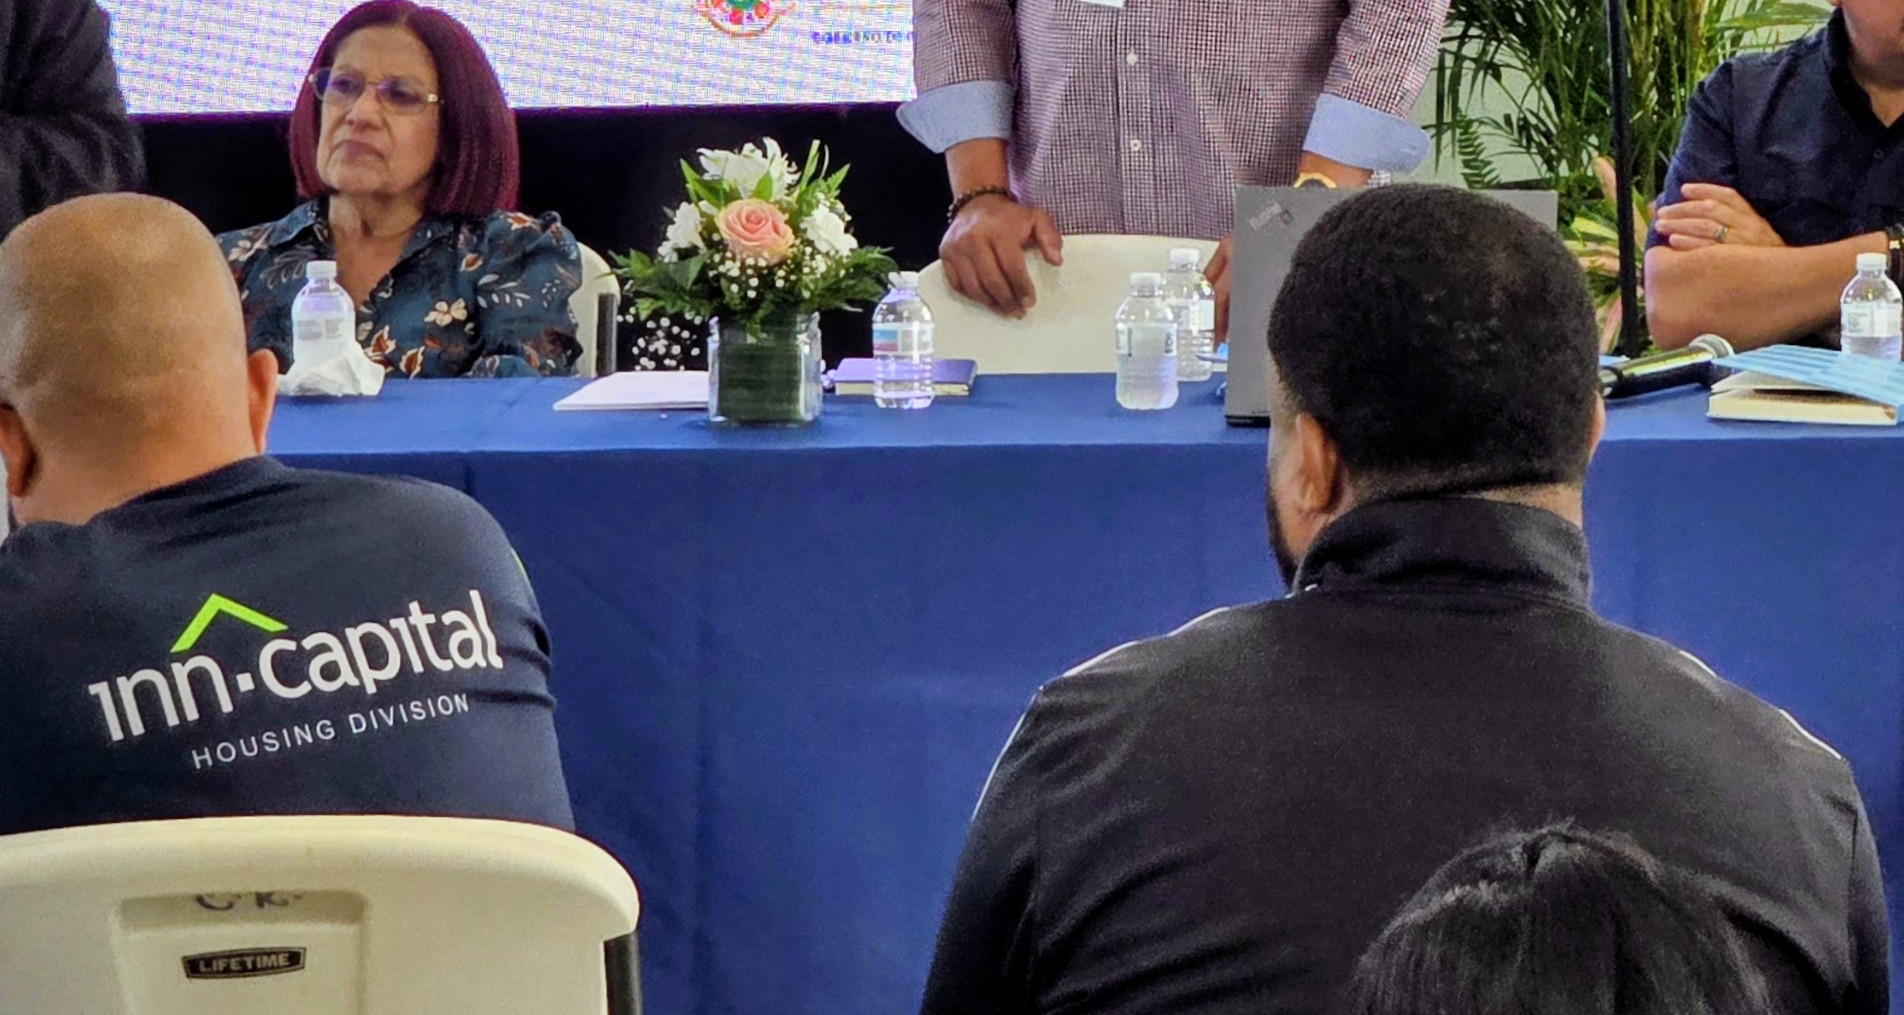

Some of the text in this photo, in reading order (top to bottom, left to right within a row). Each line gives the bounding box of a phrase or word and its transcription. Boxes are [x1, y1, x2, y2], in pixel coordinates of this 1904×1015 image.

[191, 692, 470, 770] HOUSING DIVISION
[198, 952, 291, 974] LIFETIME
